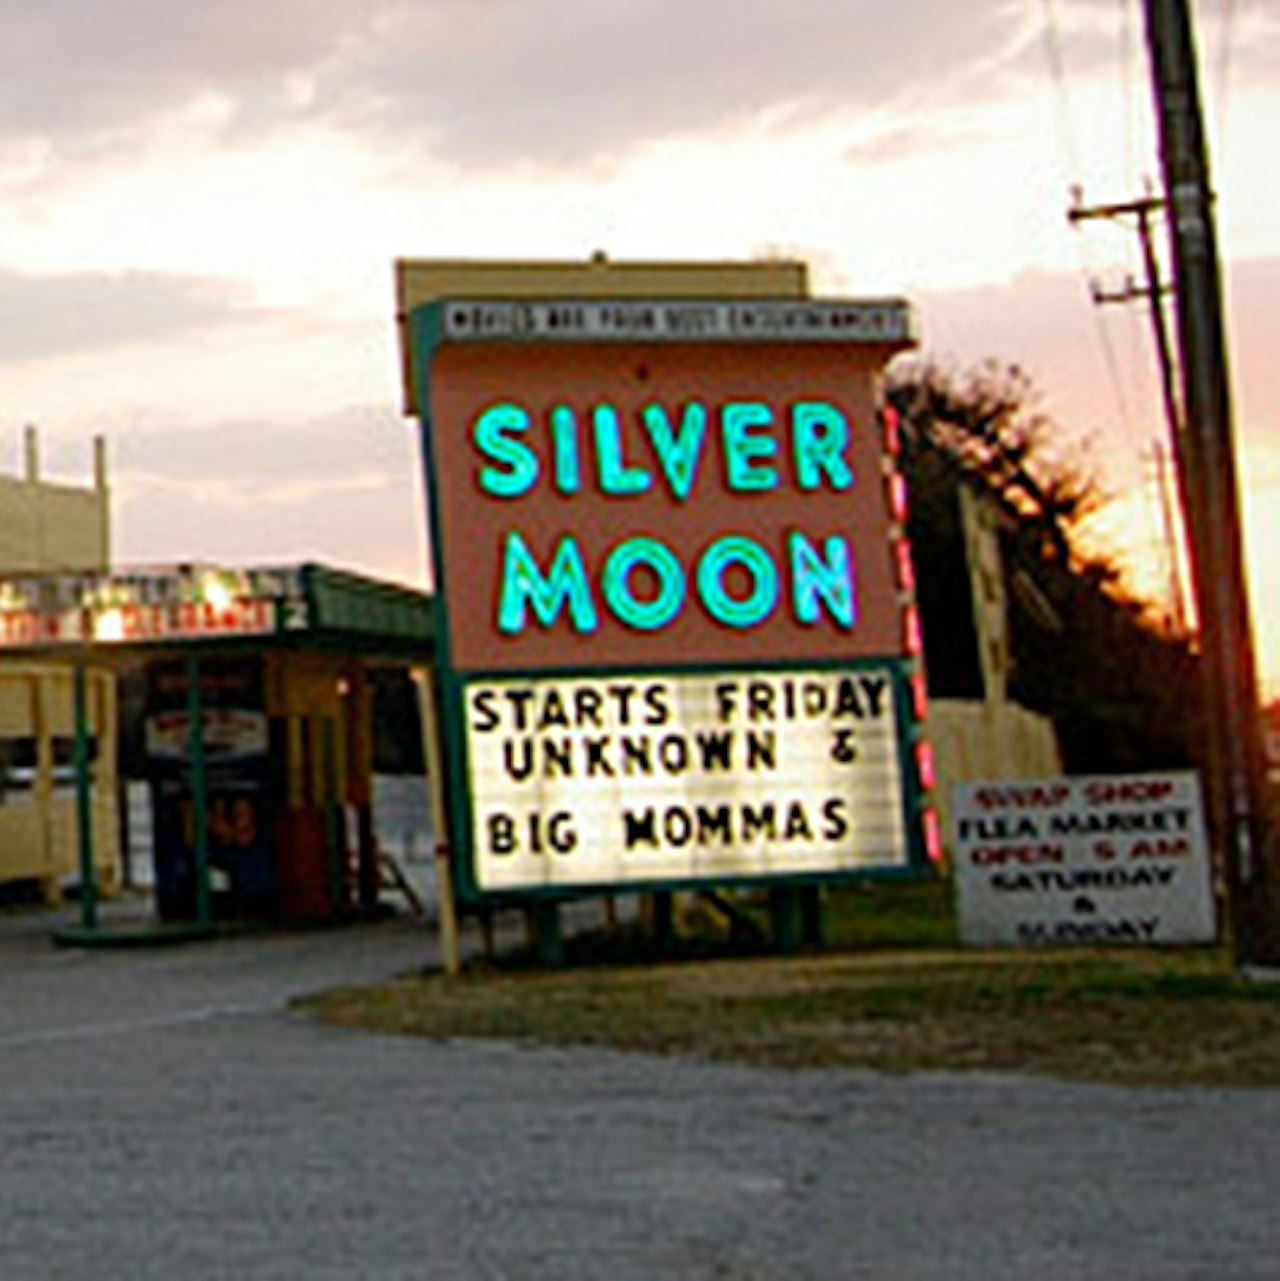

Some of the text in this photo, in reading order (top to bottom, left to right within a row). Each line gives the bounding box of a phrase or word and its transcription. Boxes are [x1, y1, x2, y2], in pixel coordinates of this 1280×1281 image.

[474, 402, 853, 500] SILVER
[498, 530, 855, 634] MOON
[472, 676, 886, 732] STARTS FRIDAY
[503, 730, 777, 782] UNKNOWN
[1084, 781, 1173, 804] SHOP
[488, 811, 578, 857] BIG
[959, 809, 1190, 840] FLEA MARKET
[970, 844, 1064, 865] OPEN
[991, 865, 1176, 891] SATURDAY
